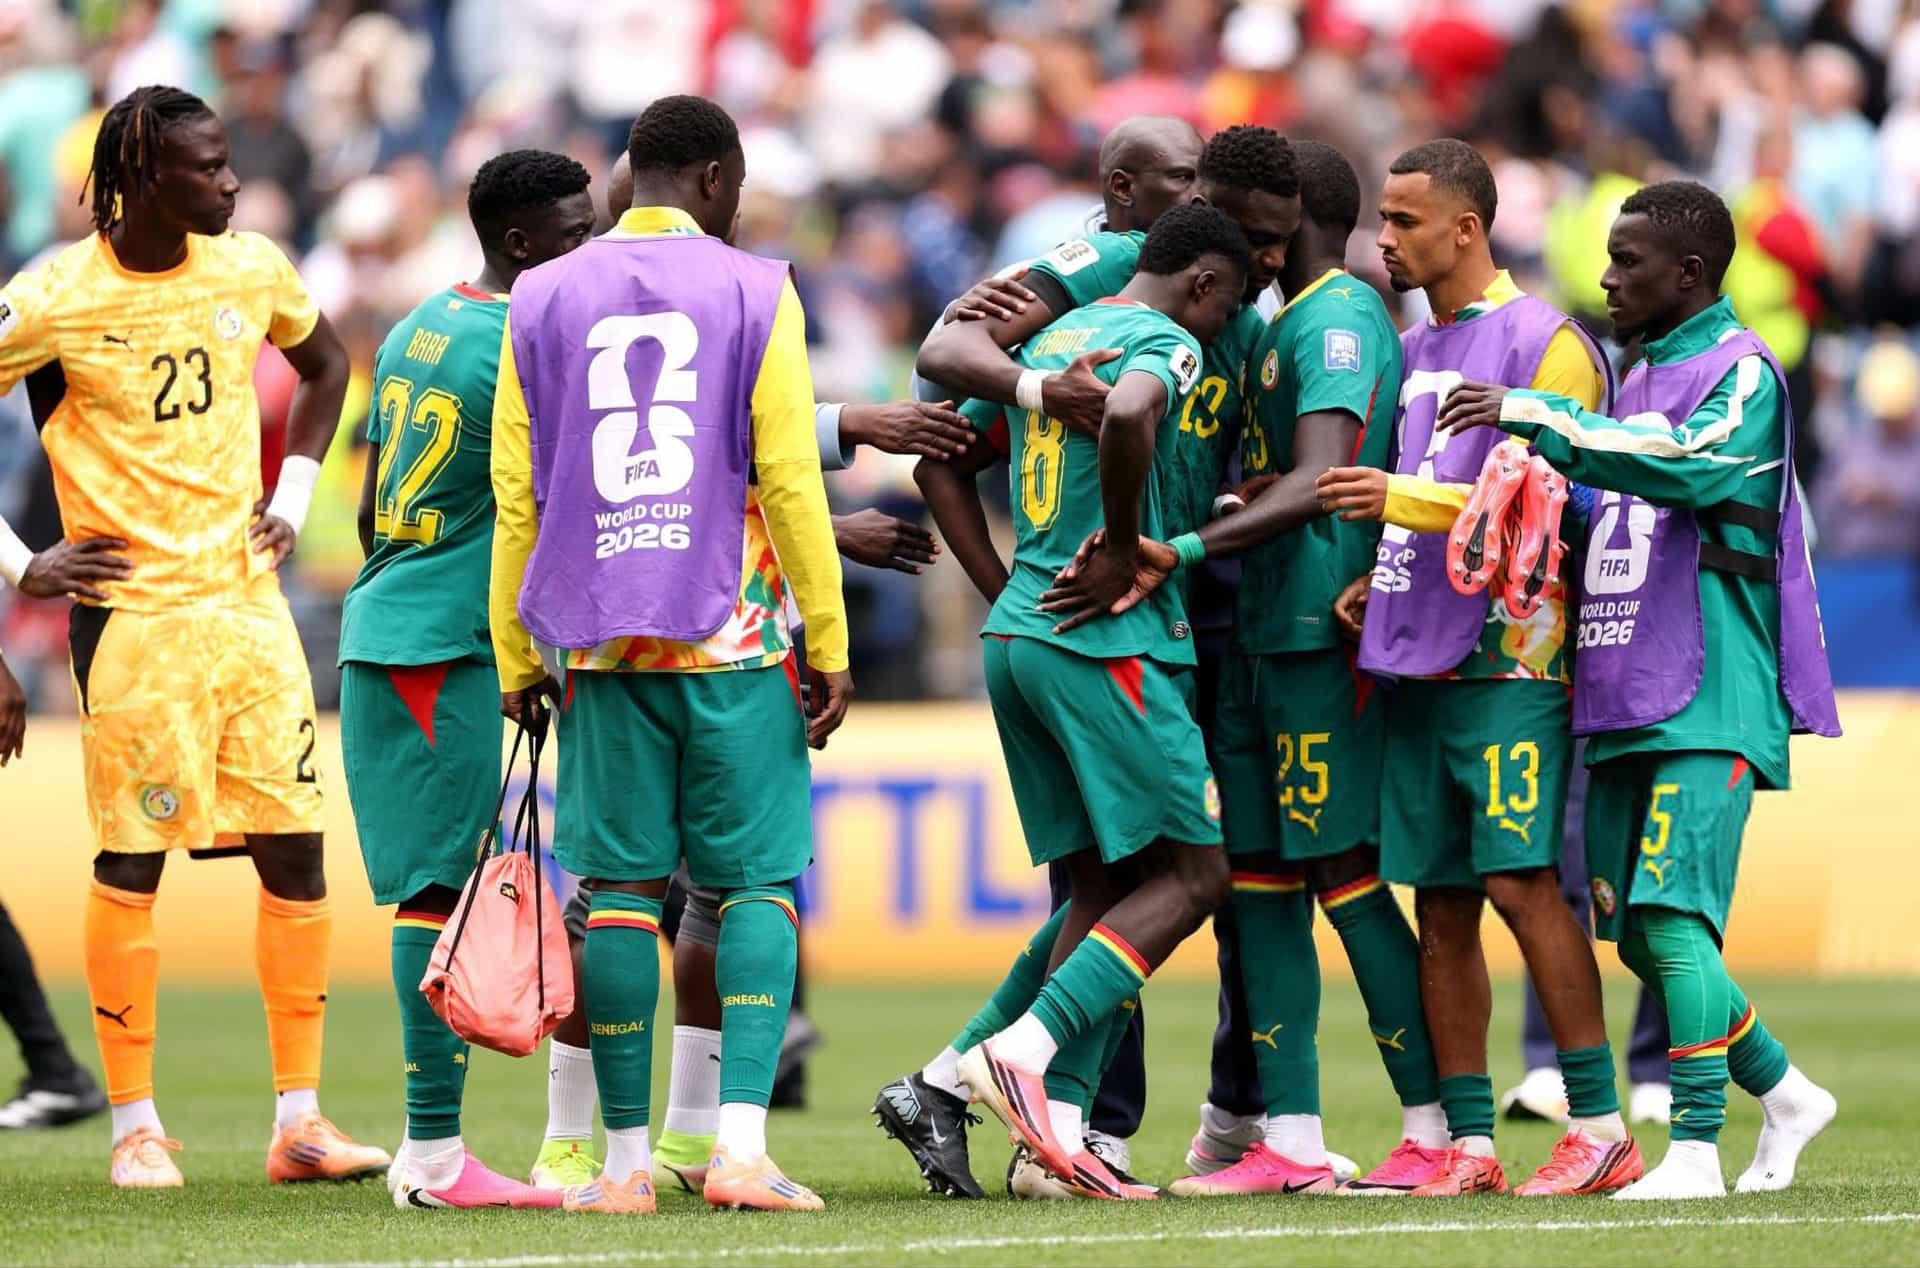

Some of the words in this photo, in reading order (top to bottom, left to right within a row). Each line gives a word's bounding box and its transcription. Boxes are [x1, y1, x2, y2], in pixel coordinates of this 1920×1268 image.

[405, 327, 450, 365] BARA
[151, 345, 213, 423] 23
[375, 375, 463, 546] 22
[624, 459, 661, 485] FIFA
[1021, 407, 1067, 531] 8
[594, 504, 647, 529] WORLD
[650, 503, 692, 520] CUP
[596, 523, 692, 560] 2026
[1599, 558, 1630, 577] FIFA
[1576, 619, 1635, 650] 2026
[296, 718, 318, 784] 2
[1277, 732, 1331, 806] 25
[1483, 741, 1540, 817] 13
[1641, 783, 1680, 856] 5
[722, 993, 776, 1008] SENEGAL
[591, 1019, 645, 1036] SENEGAL
